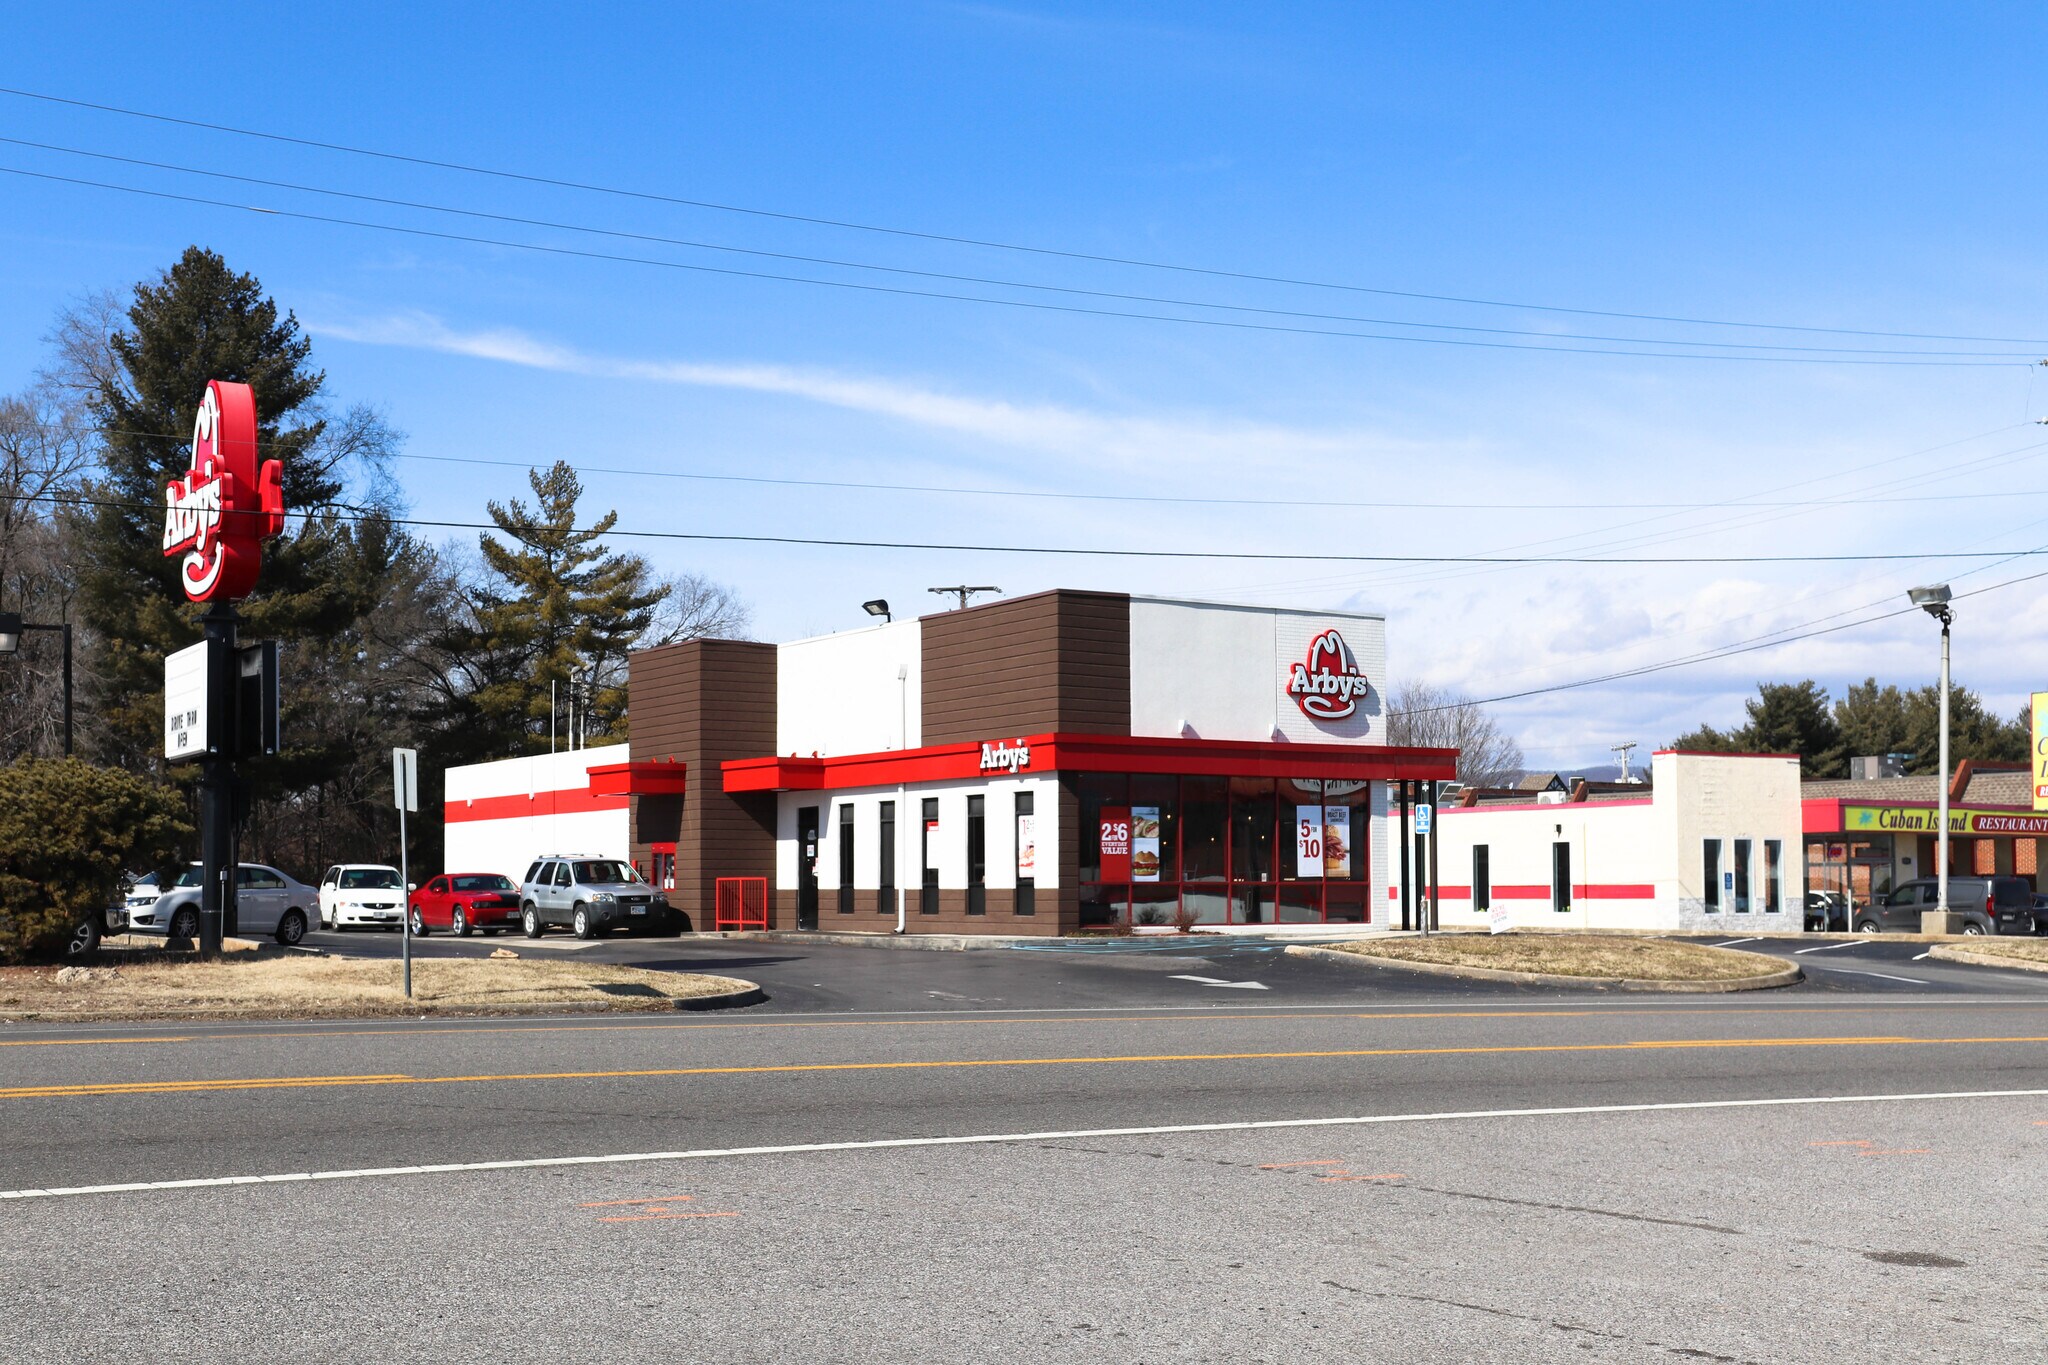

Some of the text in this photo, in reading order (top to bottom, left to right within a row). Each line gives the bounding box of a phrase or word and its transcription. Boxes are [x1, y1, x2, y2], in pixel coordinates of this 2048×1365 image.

[163, 459, 222, 550] Arby's
[1291, 665, 1367, 702] Arby's
[980, 739, 1029, 773] Arby's
[1301, 819, 1311, 838] 5
[1879, 808, 2048, 831] Cuban Isnd RESTAURANT
[1101, 822, 1112, 841] 2
[1101, 846, 1128, 855] VALUE
[1299, 839, 1320, 859] $10
